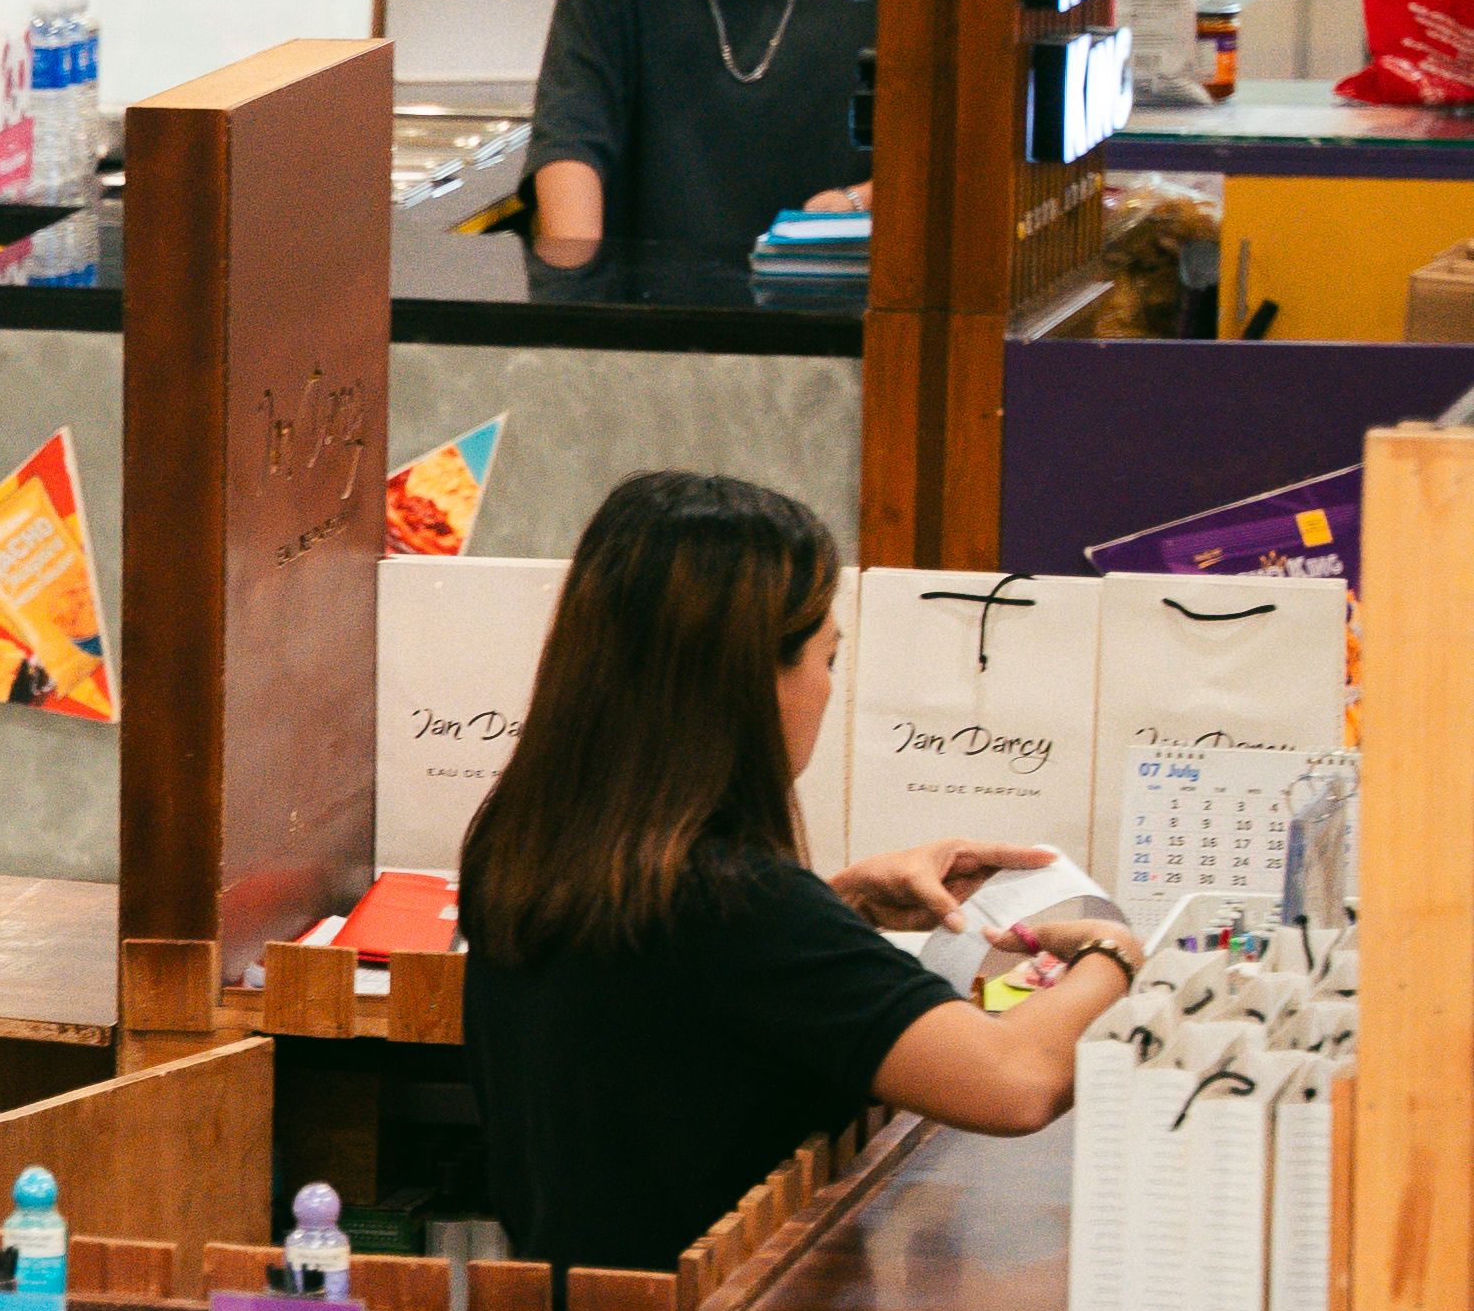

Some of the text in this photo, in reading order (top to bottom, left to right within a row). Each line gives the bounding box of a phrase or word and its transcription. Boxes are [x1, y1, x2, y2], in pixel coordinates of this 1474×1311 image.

[1062, 26, 1135, 165] KING
[412, 707, 463, 741] Jan
[892, 721, 1055, 776] Jan Darcy
[426, 767, 459, 778] EAU
[1137, 762, 1202, 783] 07 July
[907, 782, 1043, 798] EAU DE PARFUM
